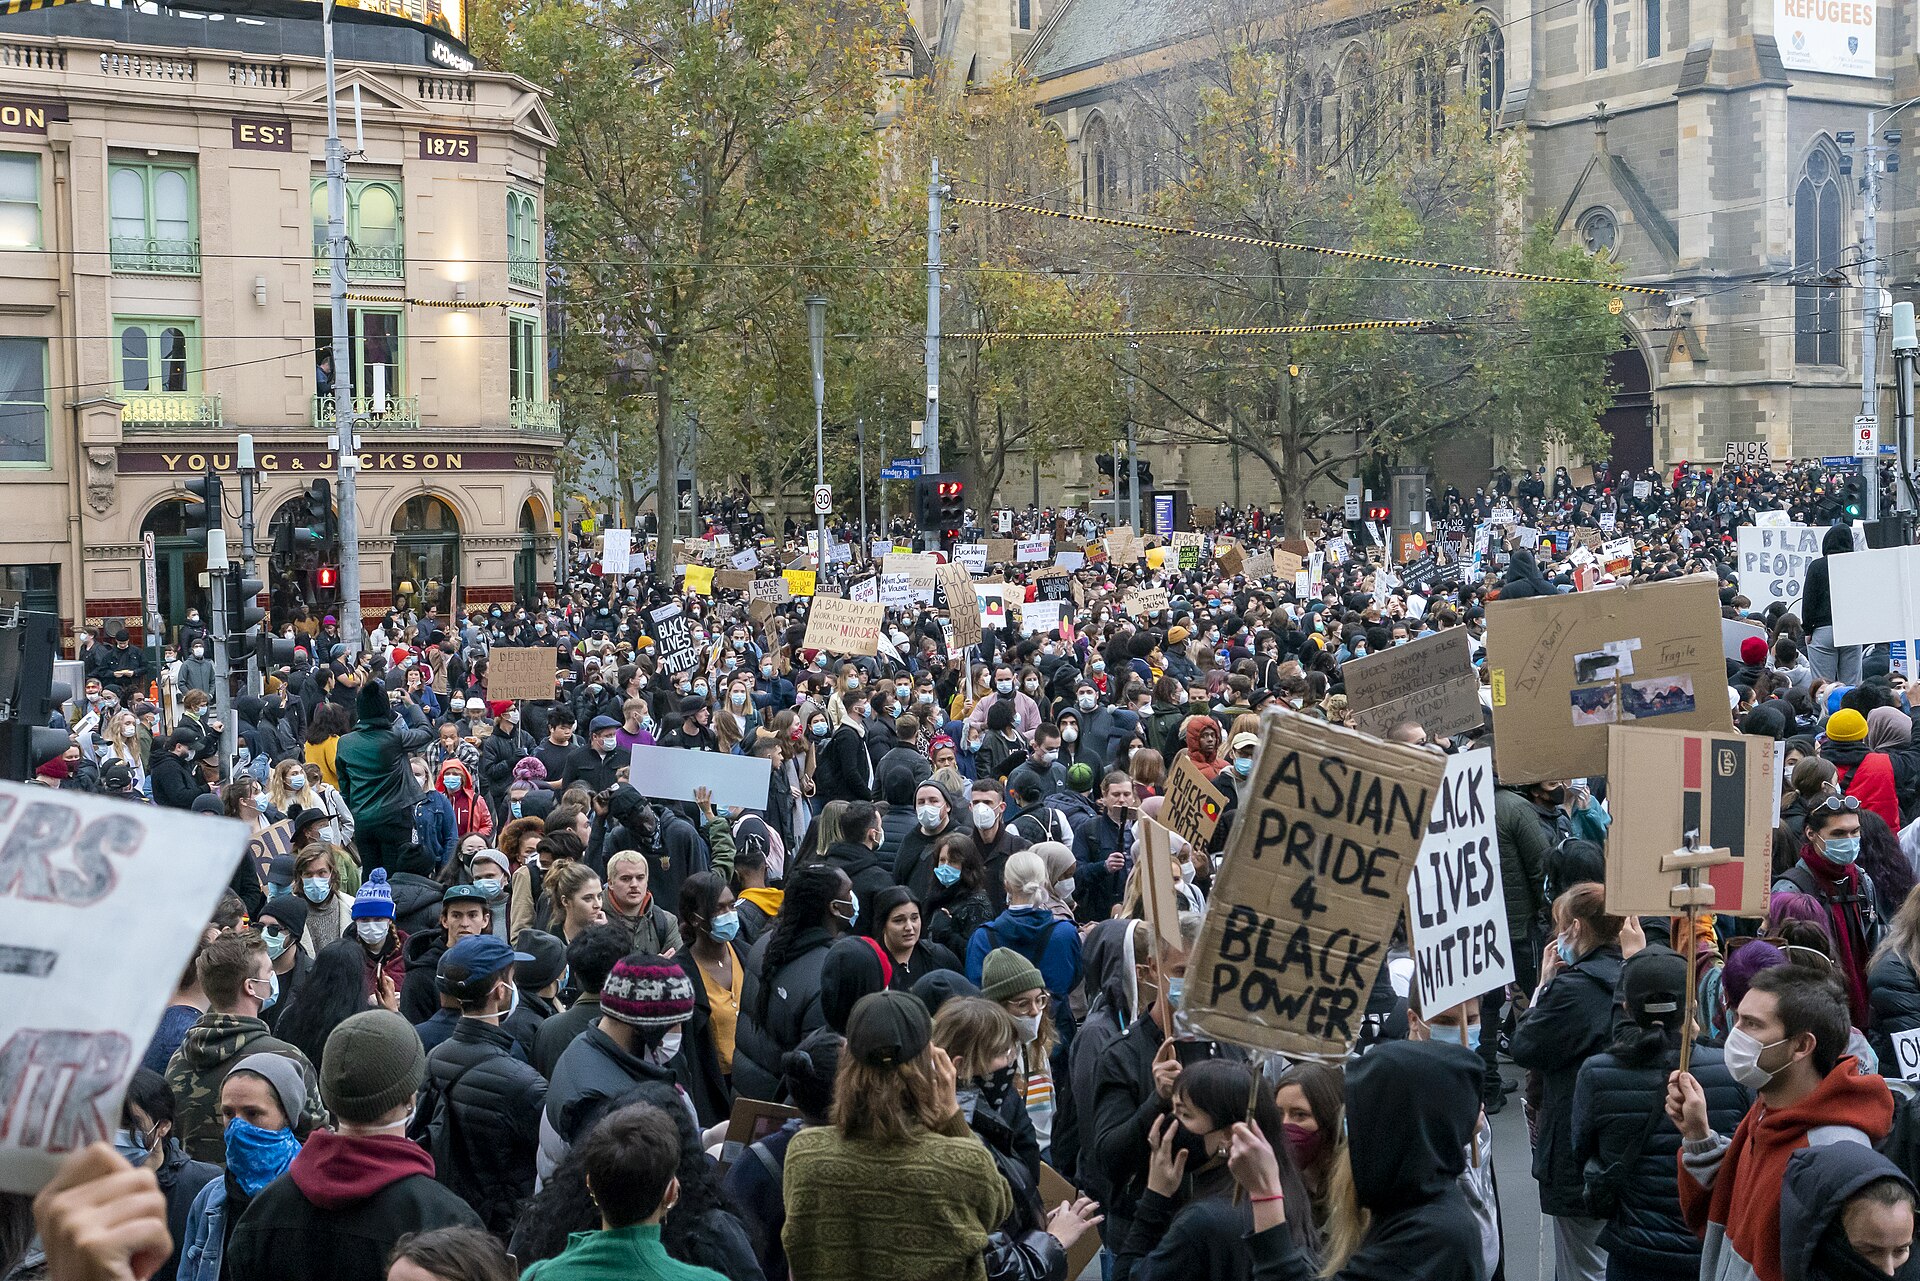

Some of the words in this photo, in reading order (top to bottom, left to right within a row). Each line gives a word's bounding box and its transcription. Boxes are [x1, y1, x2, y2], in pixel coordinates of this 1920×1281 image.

[1785, 0, 1872, 26] REFUGEES
[426, 137, 470, 157] 1875
[1726, 442, 1768, 453] FUCK
[161, 454, 279, 471] YOUG
[291, 458, 304, 469] &
[318, 454, 463, 470] JCKSON
[818, 494, 829, 504] 30
[954, 556, 984, 566] SPREMACY
[914, 578, 934, 586] RENT
[936, 563, 971, 584] BLACK
[753, 580, 780, 589] BLACK
[818, 585, 840, 593] SILENCE
[856, 581, 871, 592] STOP
[855, 589, 874, 600] DEATHS
[1139, 592, 1166, 604] SYSTEMIC
[815, 600, 822, 610] A
[825, 600, 843, 611] BAD
[849, 604, 865, 615] DAY
[868, 605, 878, 614] AT
[954, 605, 975, 616] NOT
[1143, 601, 1164, 609] RACISM
[658, 616, 689, 638] BLACK
[814, 610, 830, 619] WORK
[832, 614, 860, 624] DOESN'T
[862, 617, 880, 626] MEAN
[952, 616, 980, 634] BLACK
[840, 625, 878, 639] MURDER
[954, 630, 981, 644] DIES
[660, 632, 692, 654] LIVES
[808, 634, 836, 646] BLACK
[841, 638, 869, 650] PEOPLE
[500, 651, 544, 661] DESTROY
[662, 648, 698, 674] MATTER
[1360, 664, 1387, 679] DOES
[1394, 650, 1428, 667] ANYONE
[1436, 640, 1458, 654] ELSE
[1661, 645, 1696, 665] Fragile
[505, 672, 541, 683] POWER
[492, 685, 551, 698] STRUCTURES
[1355, 683, 1386, 699] SMELL
[1724, 751, 1734, 773] ups
[1173, 767, 1207, 812] BLACK
[1262, 751, 1428, 840] ASIAN
[1171, 786, 1203, 830] LIVES
[1428, 765, 1486, 835] LACK
[1168, 805, 1210, 851] MATTER
[1253, 809, 1400, 899] PRIDE
[1413, 836, 1494, 928] LIVES
[1761, 861, 1771, 909] Express
[1290, 875, 1328, 921] 4
[1220, 904, 1381, 990] BLACK
[1417, 919, 1505, 1006] MATTER
[1210, 963, 1359, 1042] POWER
